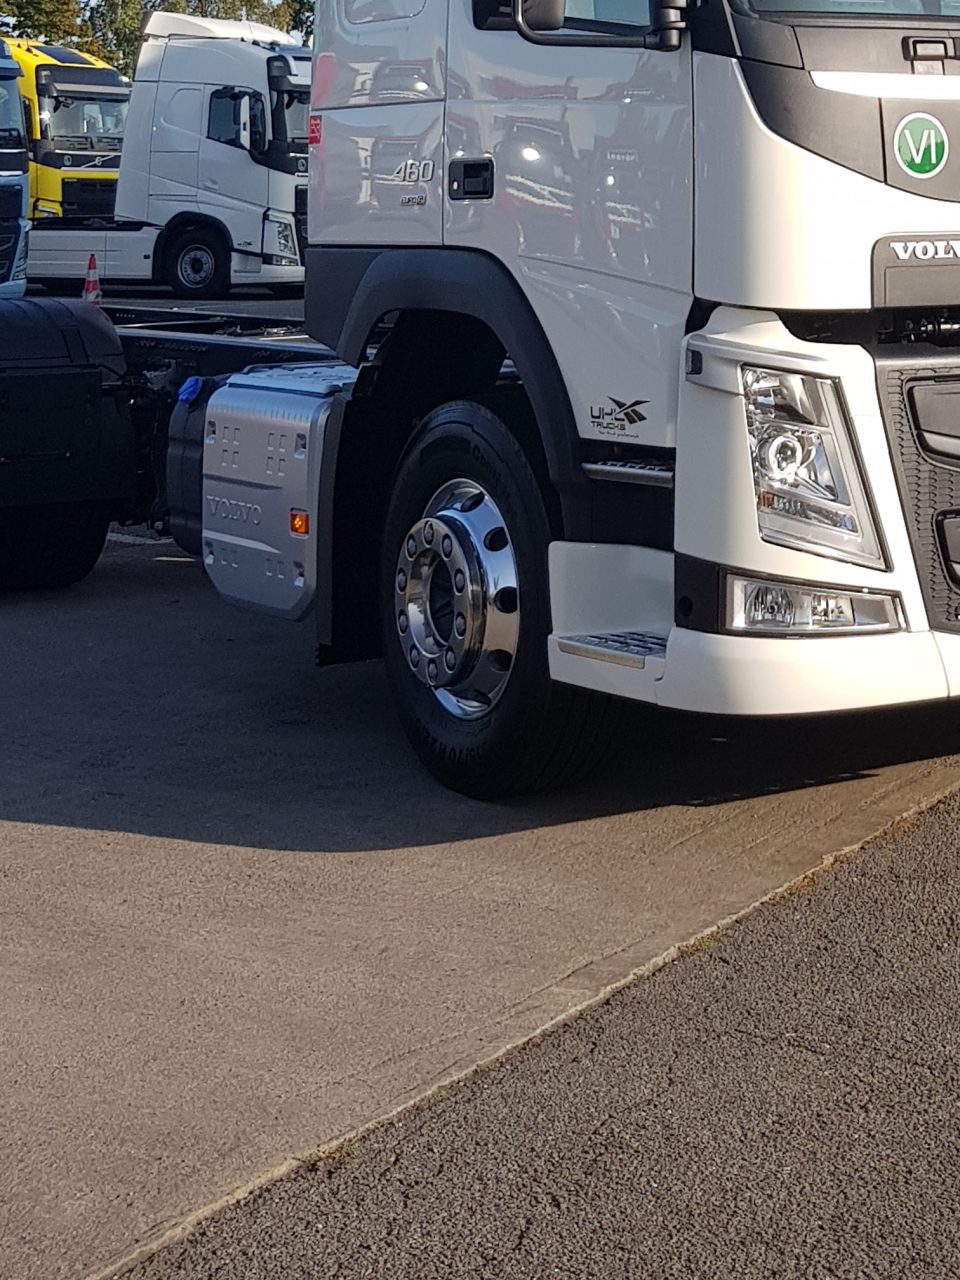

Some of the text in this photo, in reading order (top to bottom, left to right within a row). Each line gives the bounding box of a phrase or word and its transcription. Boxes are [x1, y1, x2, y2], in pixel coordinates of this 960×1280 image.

[903, 129, 937, 164] VI
[392, 159, 435, 182] 460
[590, 420, 626, 431] TRUCKS
